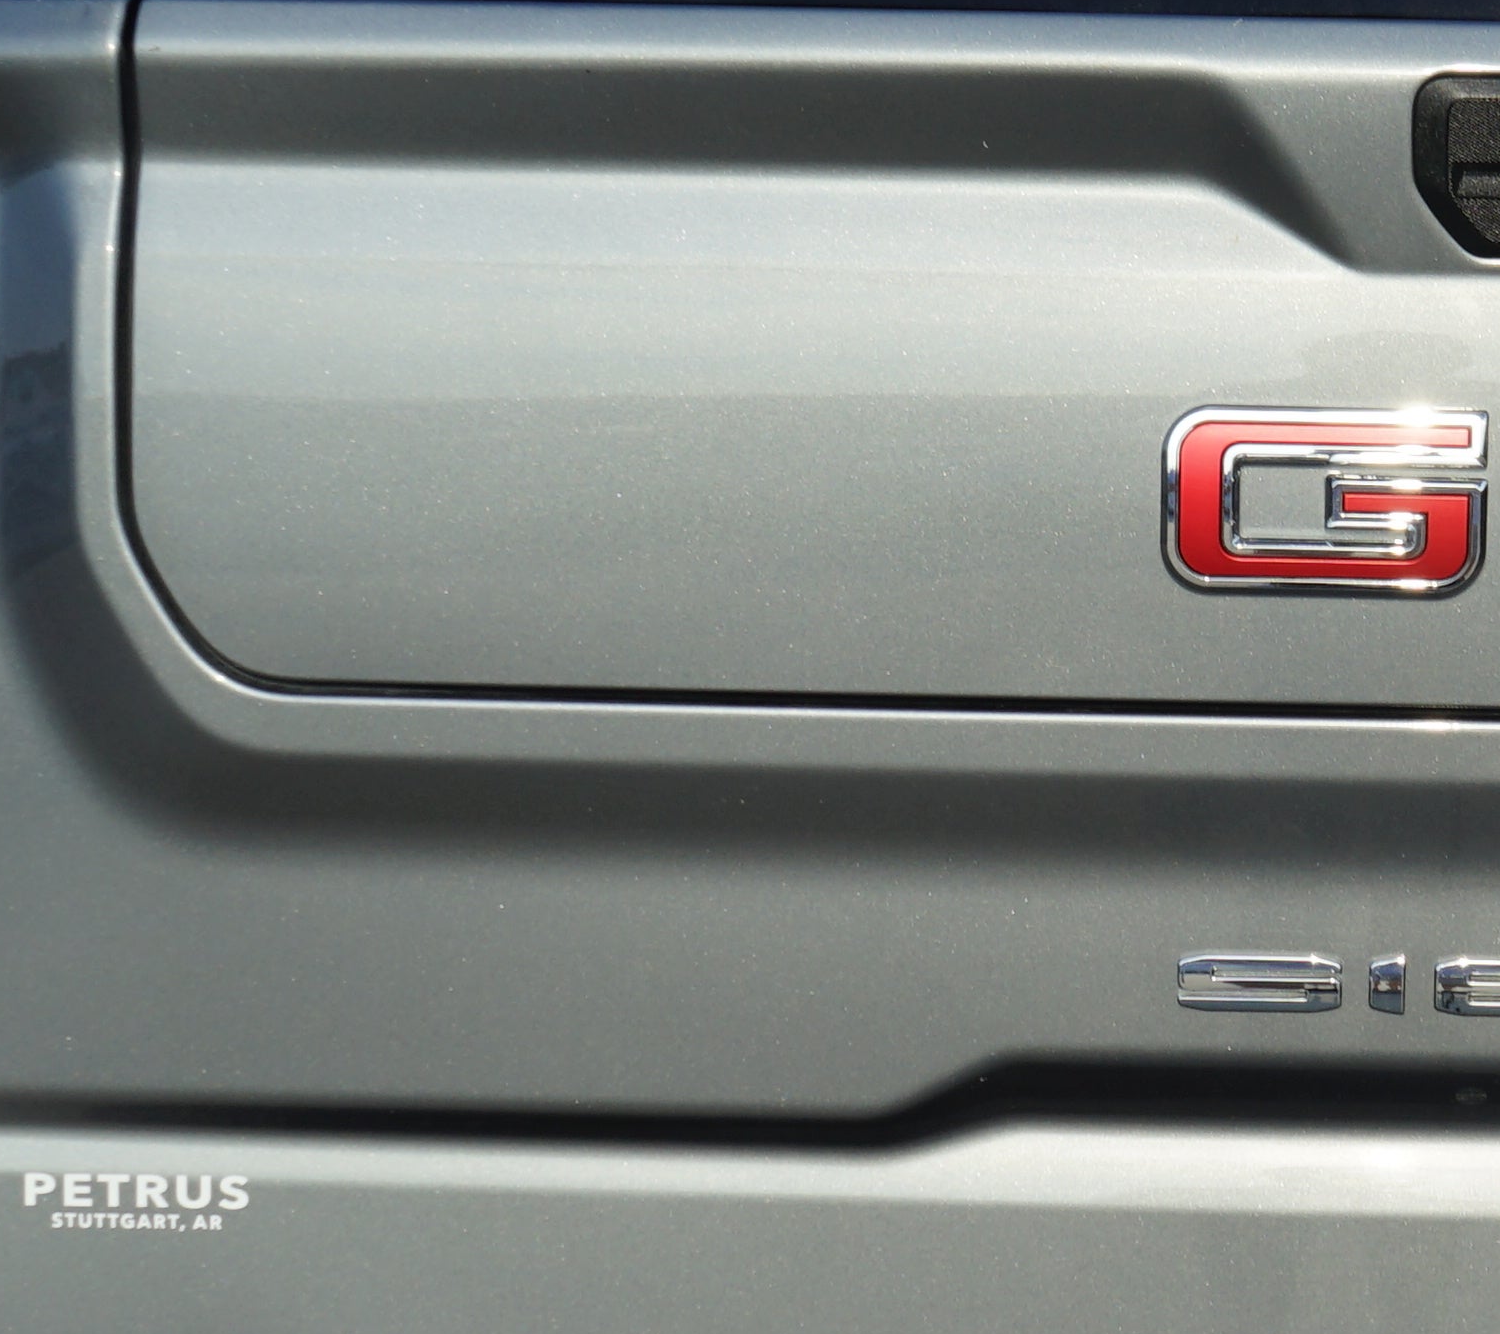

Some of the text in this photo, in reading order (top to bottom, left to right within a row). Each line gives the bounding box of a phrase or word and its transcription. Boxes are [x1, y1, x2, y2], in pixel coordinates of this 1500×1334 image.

[23, 1172, 250, 1211] PETRUS
[51, 1212, 223, 1233] STUTTGART, AR
